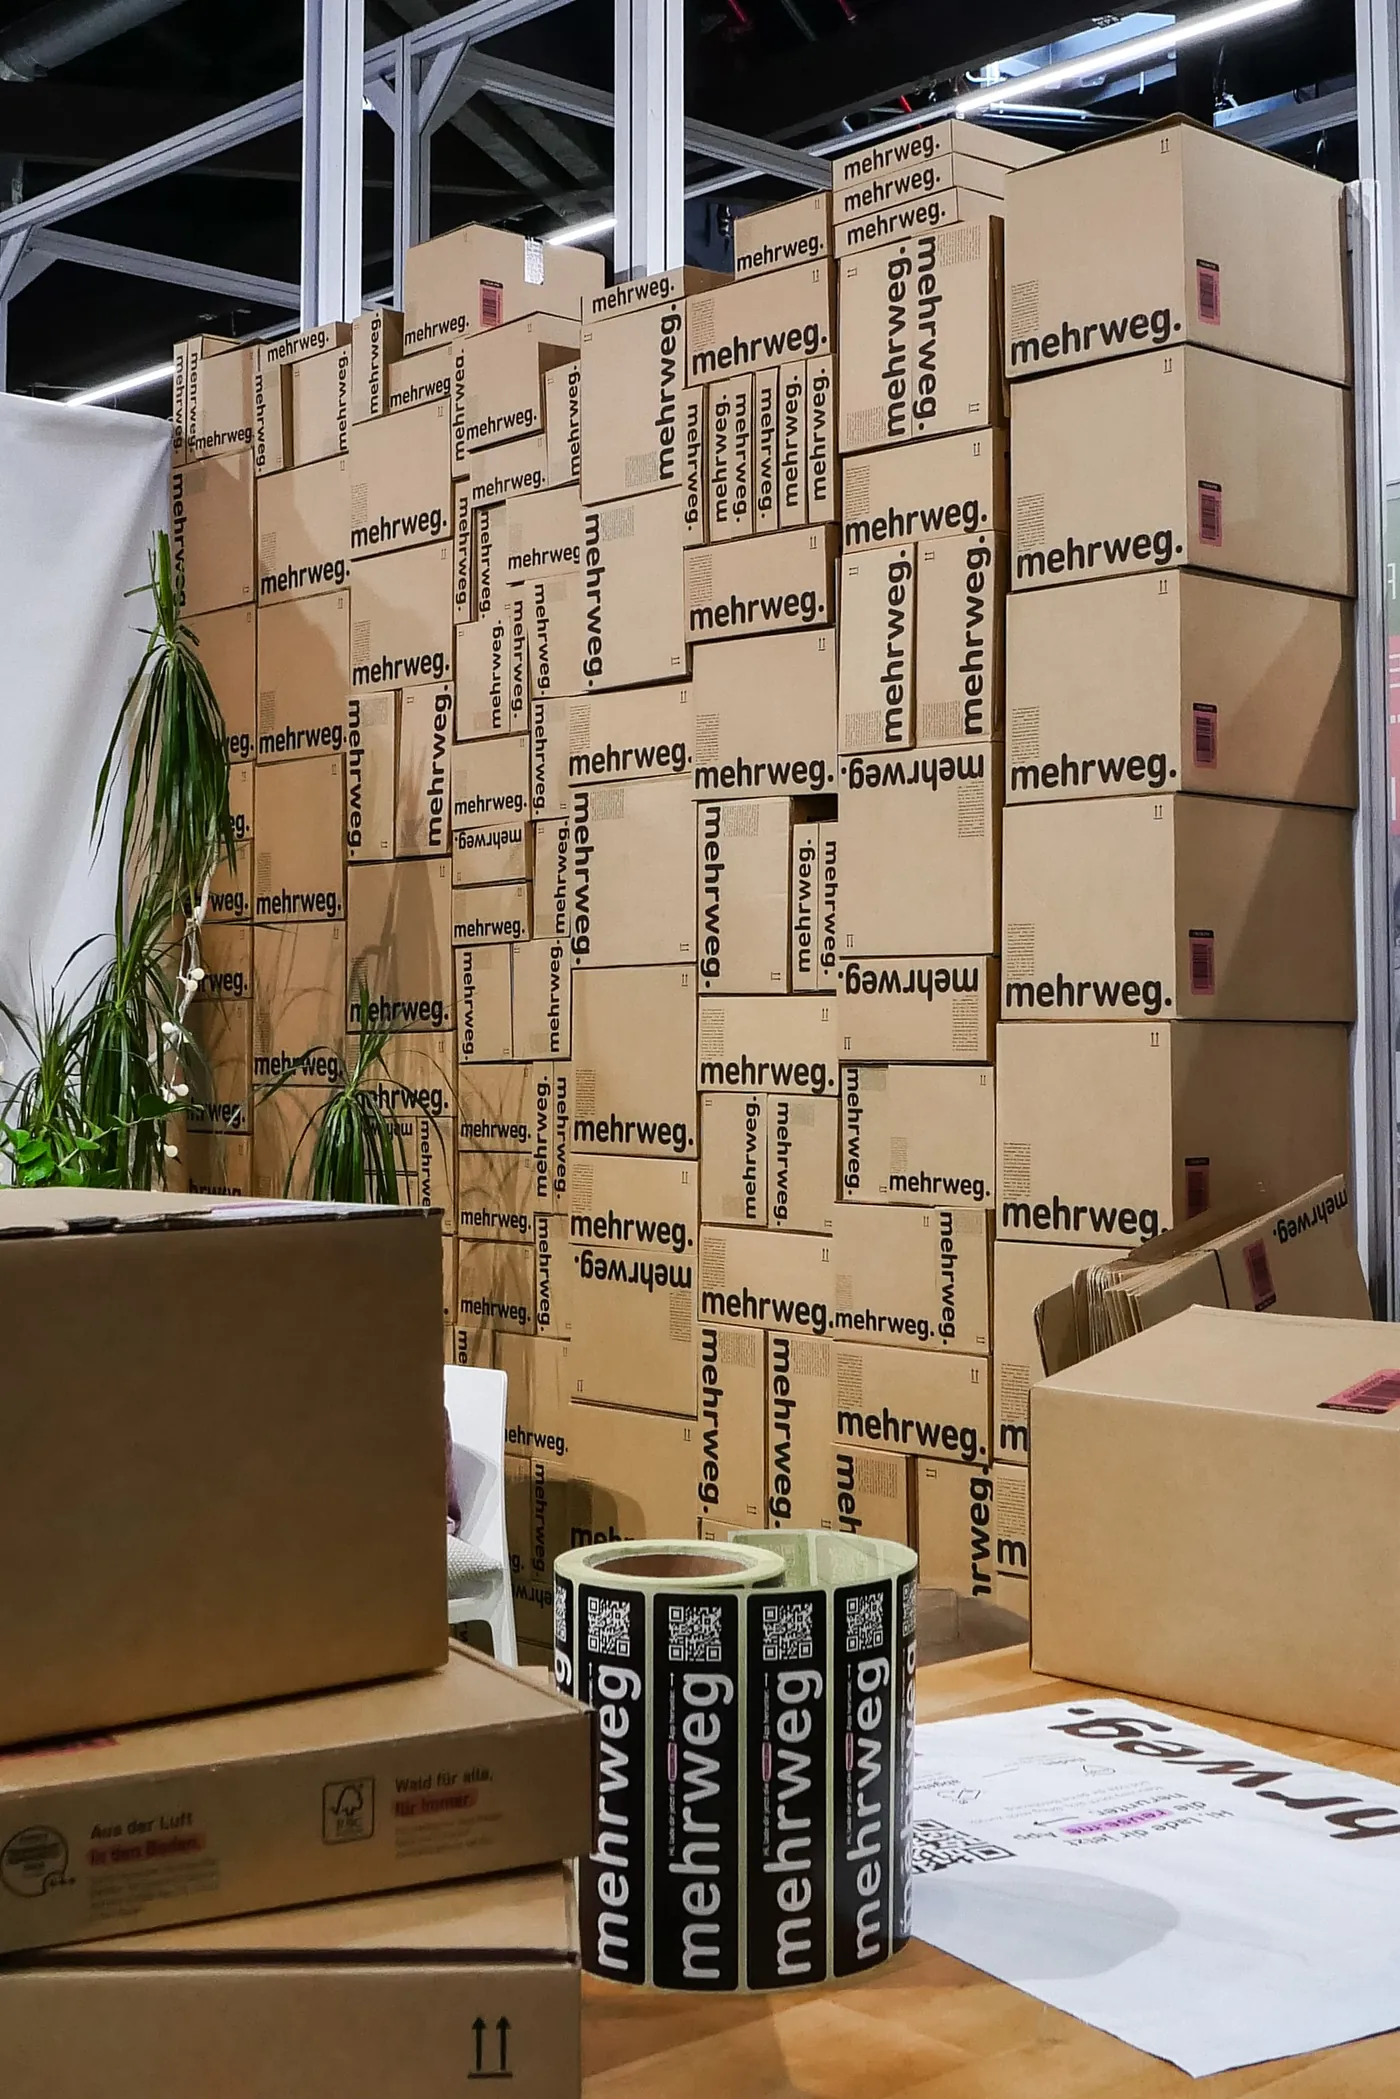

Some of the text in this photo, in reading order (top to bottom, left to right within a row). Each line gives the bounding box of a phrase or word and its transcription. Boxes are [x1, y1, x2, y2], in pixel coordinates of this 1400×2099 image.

[842, 133, 942, 182] mehrweg.
[843, 164, 942, 214] mehrweg.
[737, 236, 825, 274] mehrweg.
[846, 198, 947, 247] mehrweg.
[403, 313, 471, 347] mehrweg.
[593, 275, 676, 315] mehrweg.
[881, 245, 913, 439] mehrweg.
[911, 235, 942, 432] mehrweg.
[1012, 306, 1183, 367] mehrweg.
[265, 328, 331, 364] mehrweg.
[368, 310, 383, 415] mehrweg.
[654, 301, 683, 480] mehrweg.
[693, 321, 829, 377] mehrweg.
[172, 353, 186, 455] mehrweg.
[254, 375, 266, 473] mehrweg.
[337, 351, 349, 453] mehrweg.
[467, 409, 539, 442] mehrweg.
[568, 363, 581, 478] mehrweg.
[782, 376, 802, 507] mehrweg.
[808, 369, 829, 502] mehrweg.
[473, 471, 547, 501] mehrweg.
[685, 404, 702, 531] mehrweg.
[709, 392, 730, 524] mehrweg.
[733, 394, 747, 522] mehrweg.
[758, 388, 774, 518] mehrweg.
[351, 509, 449, 549] mehrweg.
[456, 497, 472, 612] mehrweg.
[477, 510, 492, 619] mehrweg.
[846, 498, 989, 548] mehrweg.
[1017, 527, 1184, 580] mehrweg.
[261, 559, 351, 596] mehrweg.
[583, 514, 606, 689] mehrweg.
[690, 590, 826, 632] mehrweg.
[353, 653, 451, 688] mehrweg.
[490, 620, 504, 728] mehrweg.
[511, 601, 525, 718] mehrweg.
[535, 584, 550, 695] mehrweg.
[879, 548, 914, 744] mehrweg.
[959, 534, 992, 736] mehrweg.
[259, 725, 346, 755] mehrweg.
[346, 700, 364, 858] mehrweg.
[426, 683, 453, 847] mehrweg.
[533, 704, 547, 815] mehrweg.
[569, 739, 692, 777] mehrweg.
[695, 756, 833, 791] mehrweg.
[839, 753, 984, 792] mehrweg.
[1012, 751, 1178, 793] mehrweg.
[453, 826, 521, 849] mehrweg.
[455, 795, 527, 815] mehrweg.
[257, 888, 341, 917] mehrweg.
[553, 819, 571, 935] mehrweg.
[572, 793, 594, 965] mehrweg.
[698, 807, 725, 988] mehrweg.
[794, 840, 815, 972] mehrweg.
[820, 841, 840, 977] mehrweg.
[454, 919, 525, 939] mehrweg.
[462, 952, 477, 1062] mehrweg.
[546, 938, 563, 1052] mehrweg.
[836, 963, 978, 1002] mehrweg.
[1006, 971, 1172, 1015] mehrweg.
[700, 1054, 836, 1096] mehrweg.
[421, 1120, 433, 1206] mehrwe
[461, 1119, 531, 1144] mehrweg.
[534, 1076, 550, 1197] mehrweg.
[553, 1076, 571, 1199] mehrweg.
[572, 1113, 693, 1154] mehrweg.
[742, 1096, 760, 1219] mehrweg.
[774, 1103, 792, 1226] mehrweg.
[845, 1067, 865, 1195] mehrweg.
[461, 1208, 531, 1234] mehrweg.
[569, 1210, 693, 1252] mehrweg.
[889, 1171, 990, 1203] mehrweg.
[1271, 1187, 1348, 1244] mehrweg.
[461, 1297, 530, 1326] mehrweg.
[535, 1216, 553, 1333] mehrweg.
[574, 1250, 691, 1294] mehrweg.
[701, 1286, 833, 1337] mehrweg.
[938, 1212, 958, 1345] mehrweg.
[834, 1309, 934, 1342] mehrweg.
[505, 1425, 569, 1456] ehrweg.
[699, 1329, 723, 1513] mehrweg.
[767, 1337, 796, 1529] mehrweg.
[836, 1407, 986, 1463] mehrweg.
[971, 1465, 993, 1597] rweg.
[589, 1664, 641, 1971] mehrweg
[669, 1672, 734, 1979] mehrweg
[763, 1668, 823, 1977] mehrweg
[845, 1656, 890, 1961] mehrweg
[1151, 1816, 1203, 1831] lade
[1173, 1800, 1207, 1812] die
